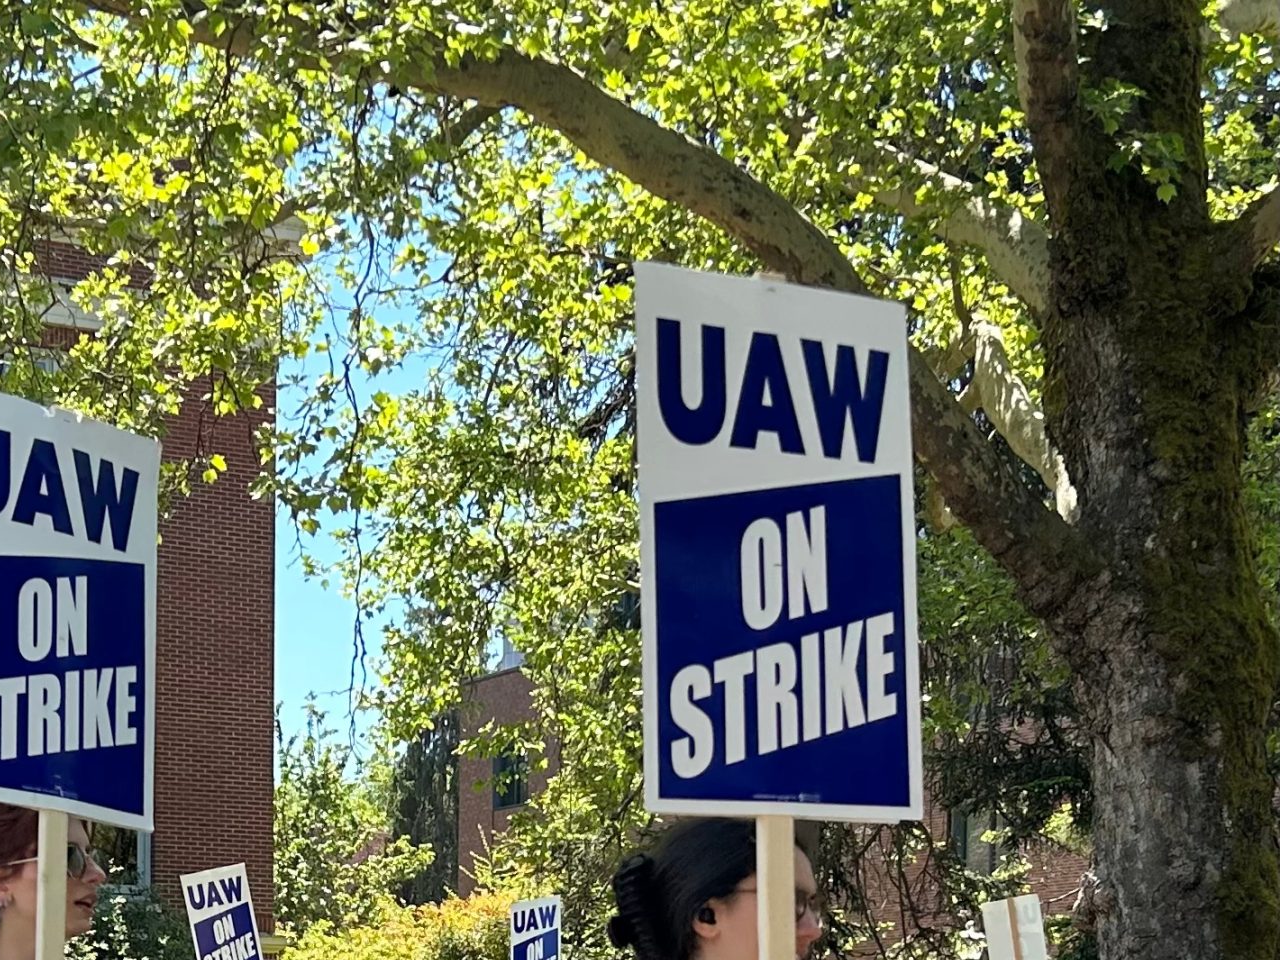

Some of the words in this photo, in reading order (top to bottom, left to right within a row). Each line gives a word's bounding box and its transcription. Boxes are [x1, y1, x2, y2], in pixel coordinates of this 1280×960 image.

[655, 317, 890, 464] UAW
[740, 505, 828, 631] ON
[17, 575, 88, 662] ON
[669, 611, 897, 779] STRIKE
[186, 875, 242, 911] UAW
[212, 913, 236, 945] ON
[513, 904, 557, 934] UAW
